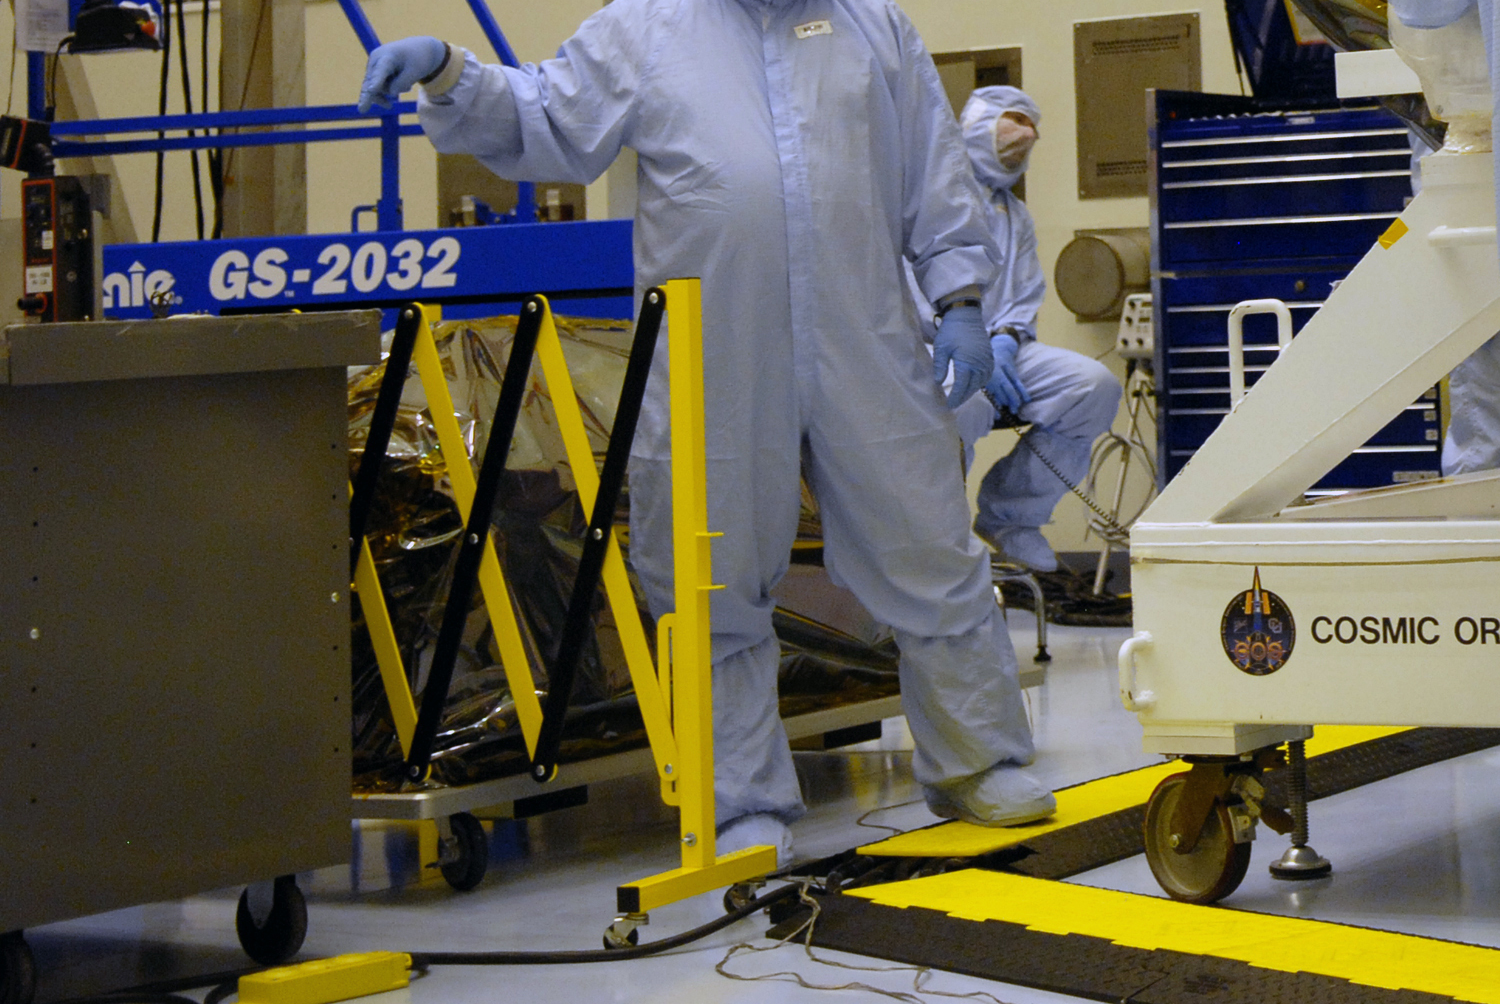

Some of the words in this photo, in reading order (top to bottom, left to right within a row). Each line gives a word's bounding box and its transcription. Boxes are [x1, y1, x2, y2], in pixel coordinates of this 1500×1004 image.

[103, 261, 175, 308] nie
[208, 236, 461, 301] GS-2032
[1310, 616, 1440, 645] COSMIC
